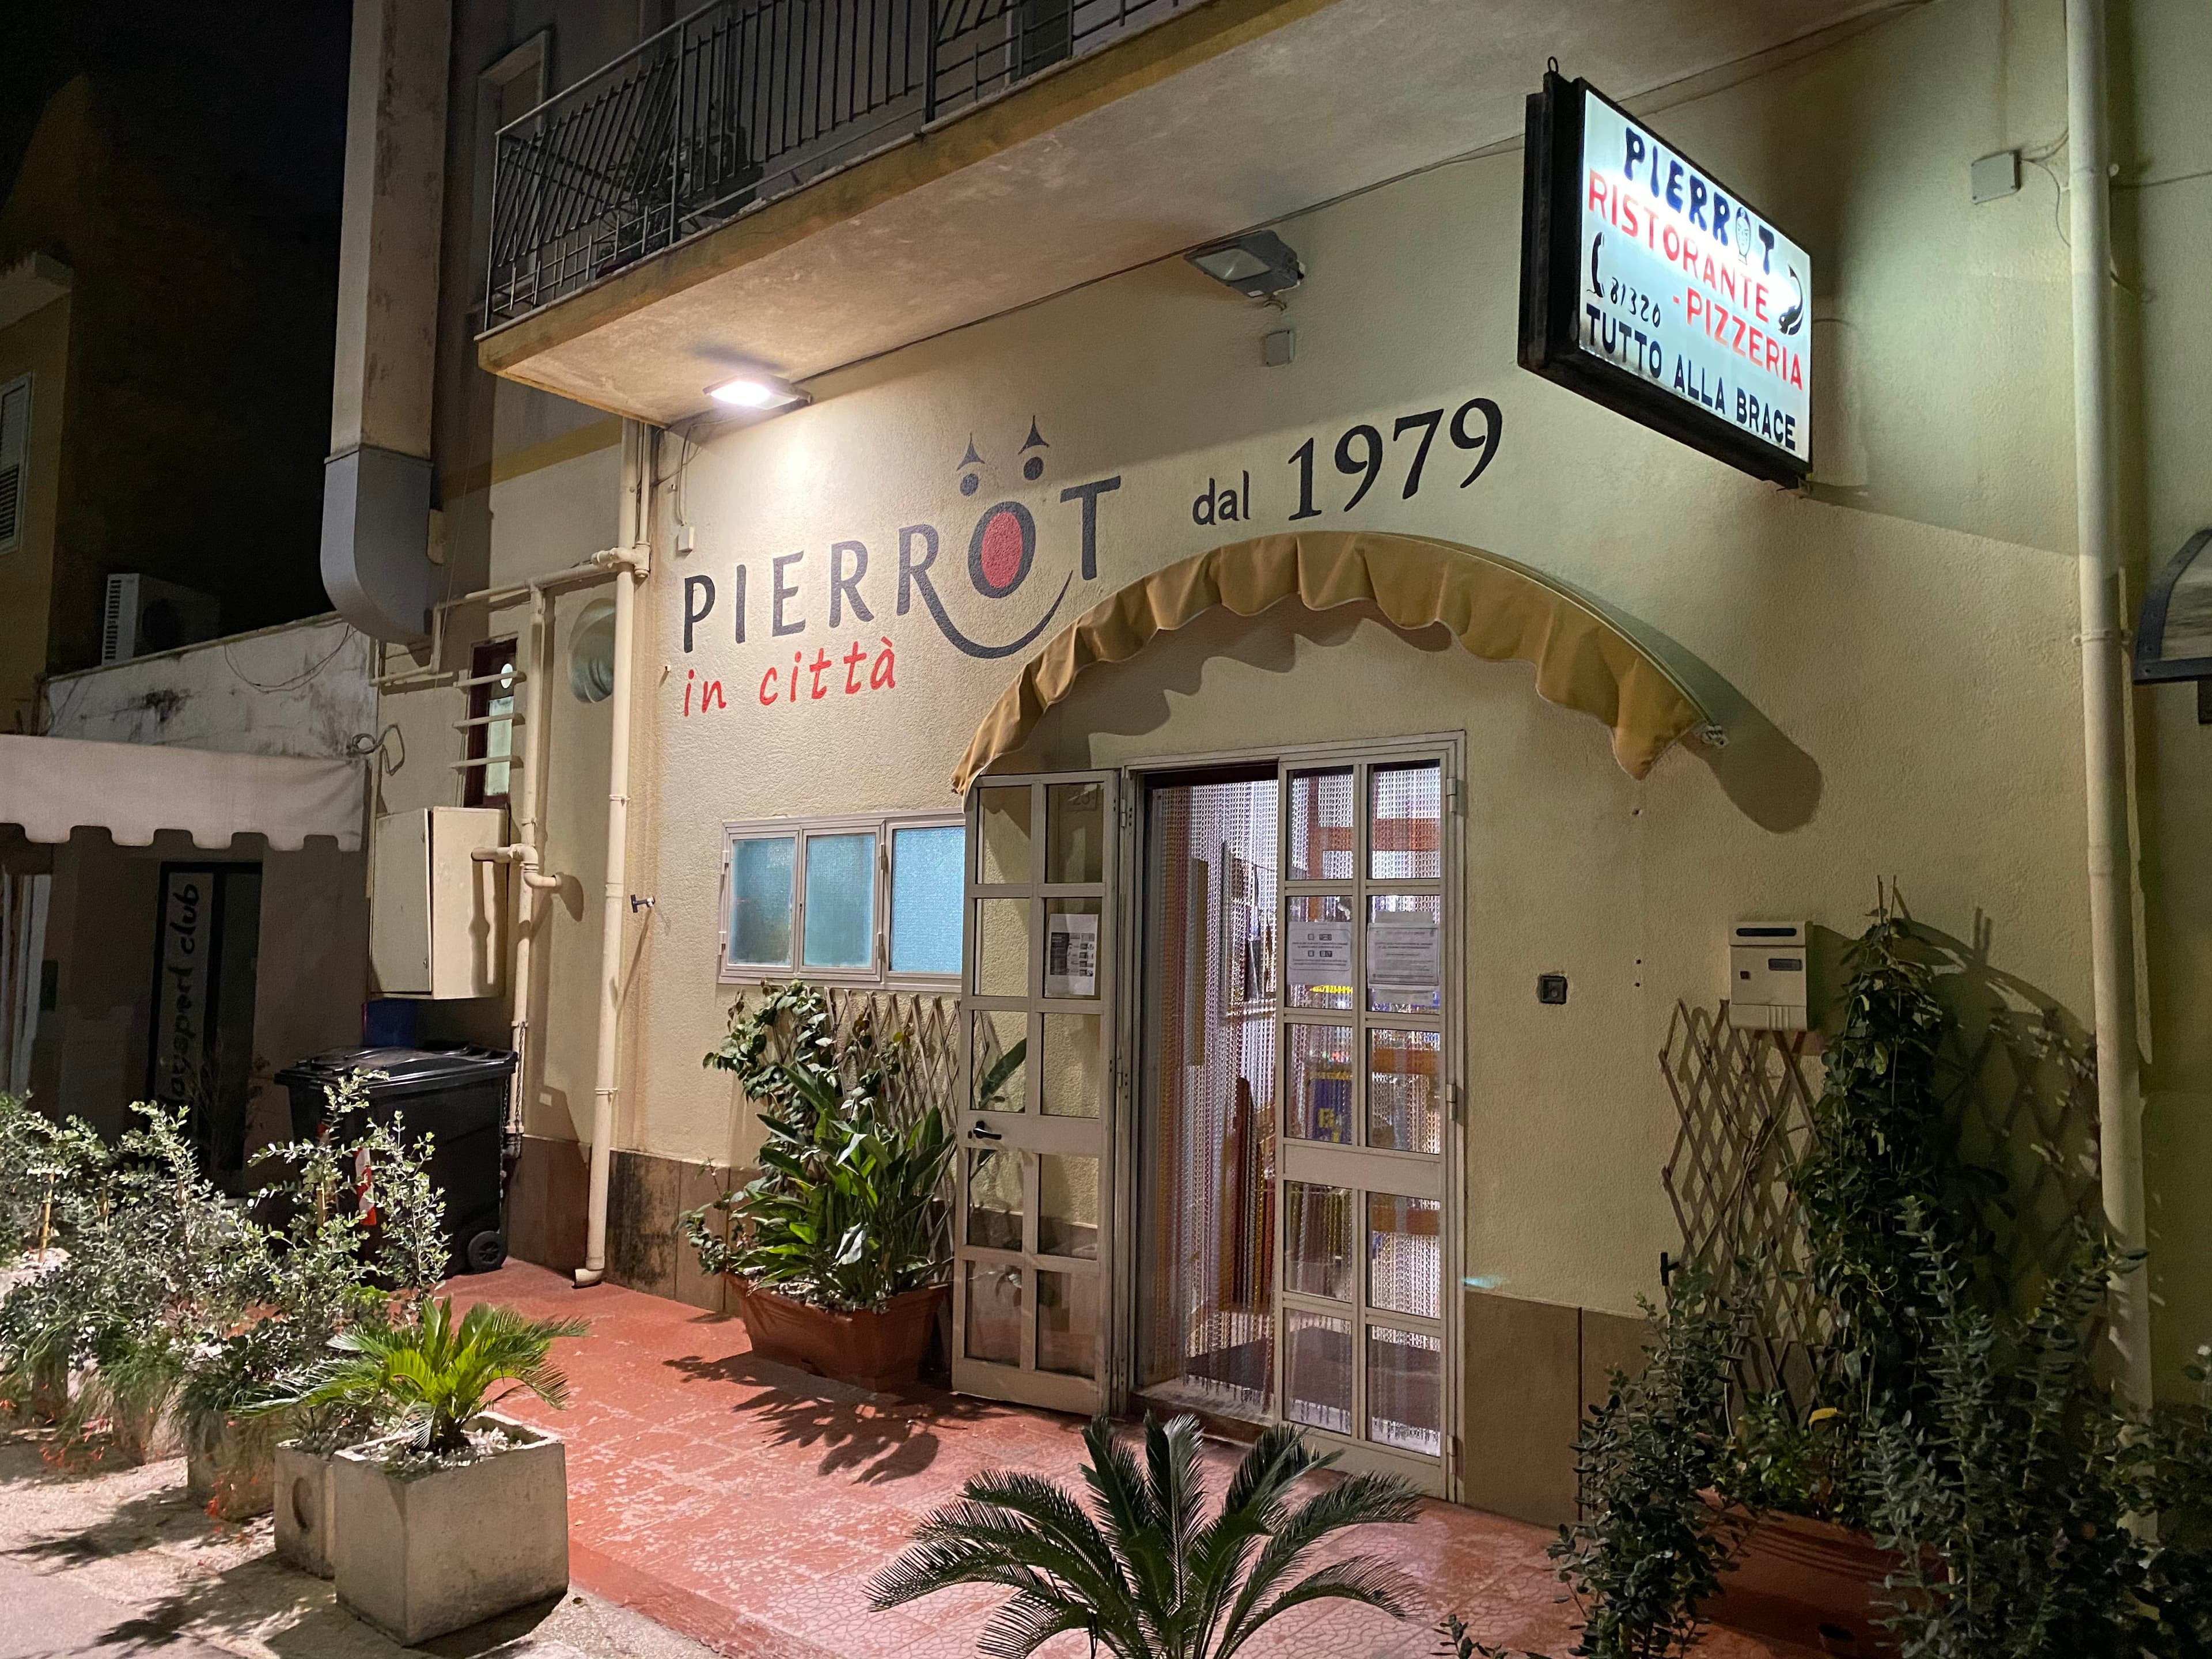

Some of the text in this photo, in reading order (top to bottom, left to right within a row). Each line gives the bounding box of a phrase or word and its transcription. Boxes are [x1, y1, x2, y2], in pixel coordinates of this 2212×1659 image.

[1589, 168, 1770, 323] RISTORANTE
[1610, 276, 1661, 328] 81320
[1586, 302, 1796, 450] TUTTO ALLA BRACE
[1192, 397, 1502, 525] dal 1979
[683, 636, 896, 717] in città
[169, 883, 199, 954] club
